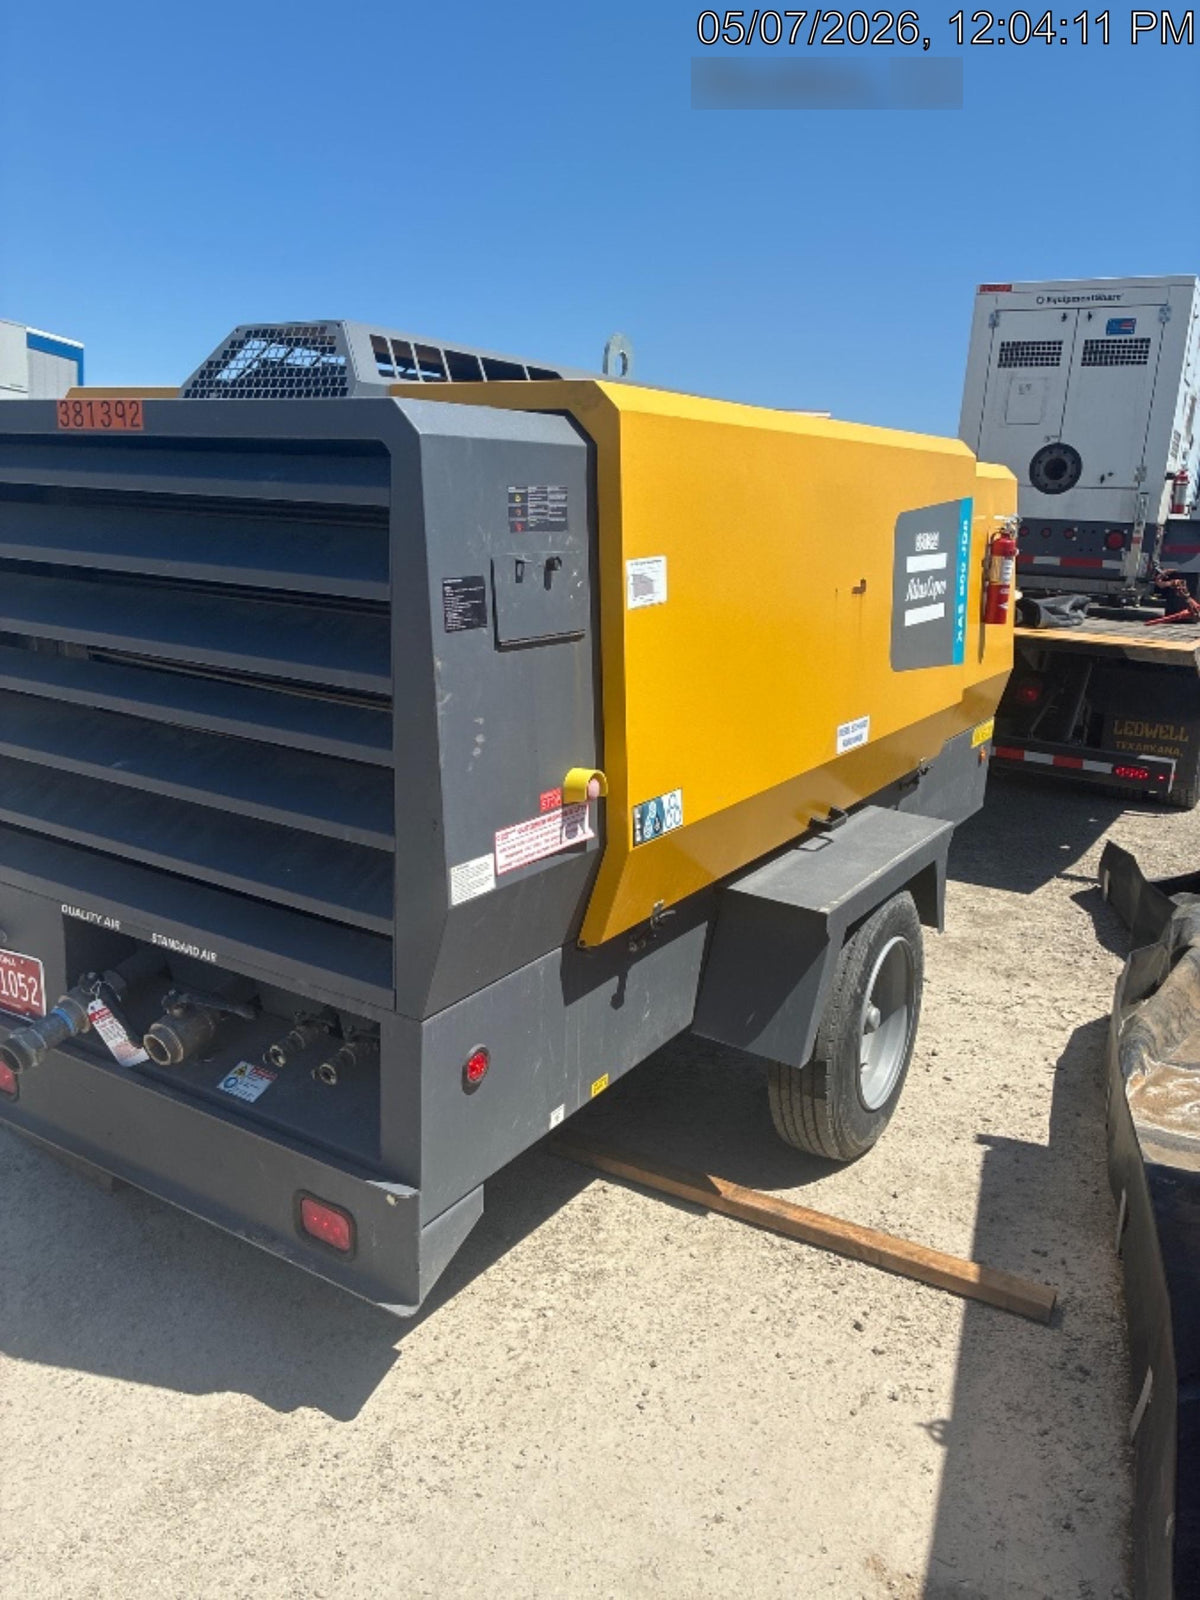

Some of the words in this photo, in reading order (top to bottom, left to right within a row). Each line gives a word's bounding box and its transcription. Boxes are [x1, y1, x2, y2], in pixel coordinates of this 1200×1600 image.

[59, 400, 140, 428] 381392
[1113, 720, 1190, 742] LEDWELL
[61, 904, 102, 924] QUALITY
[104, 916, 121, 930] AIR
[152, 932, 200, 957] STANDARD
[200, 948, 217, 962] AIR
